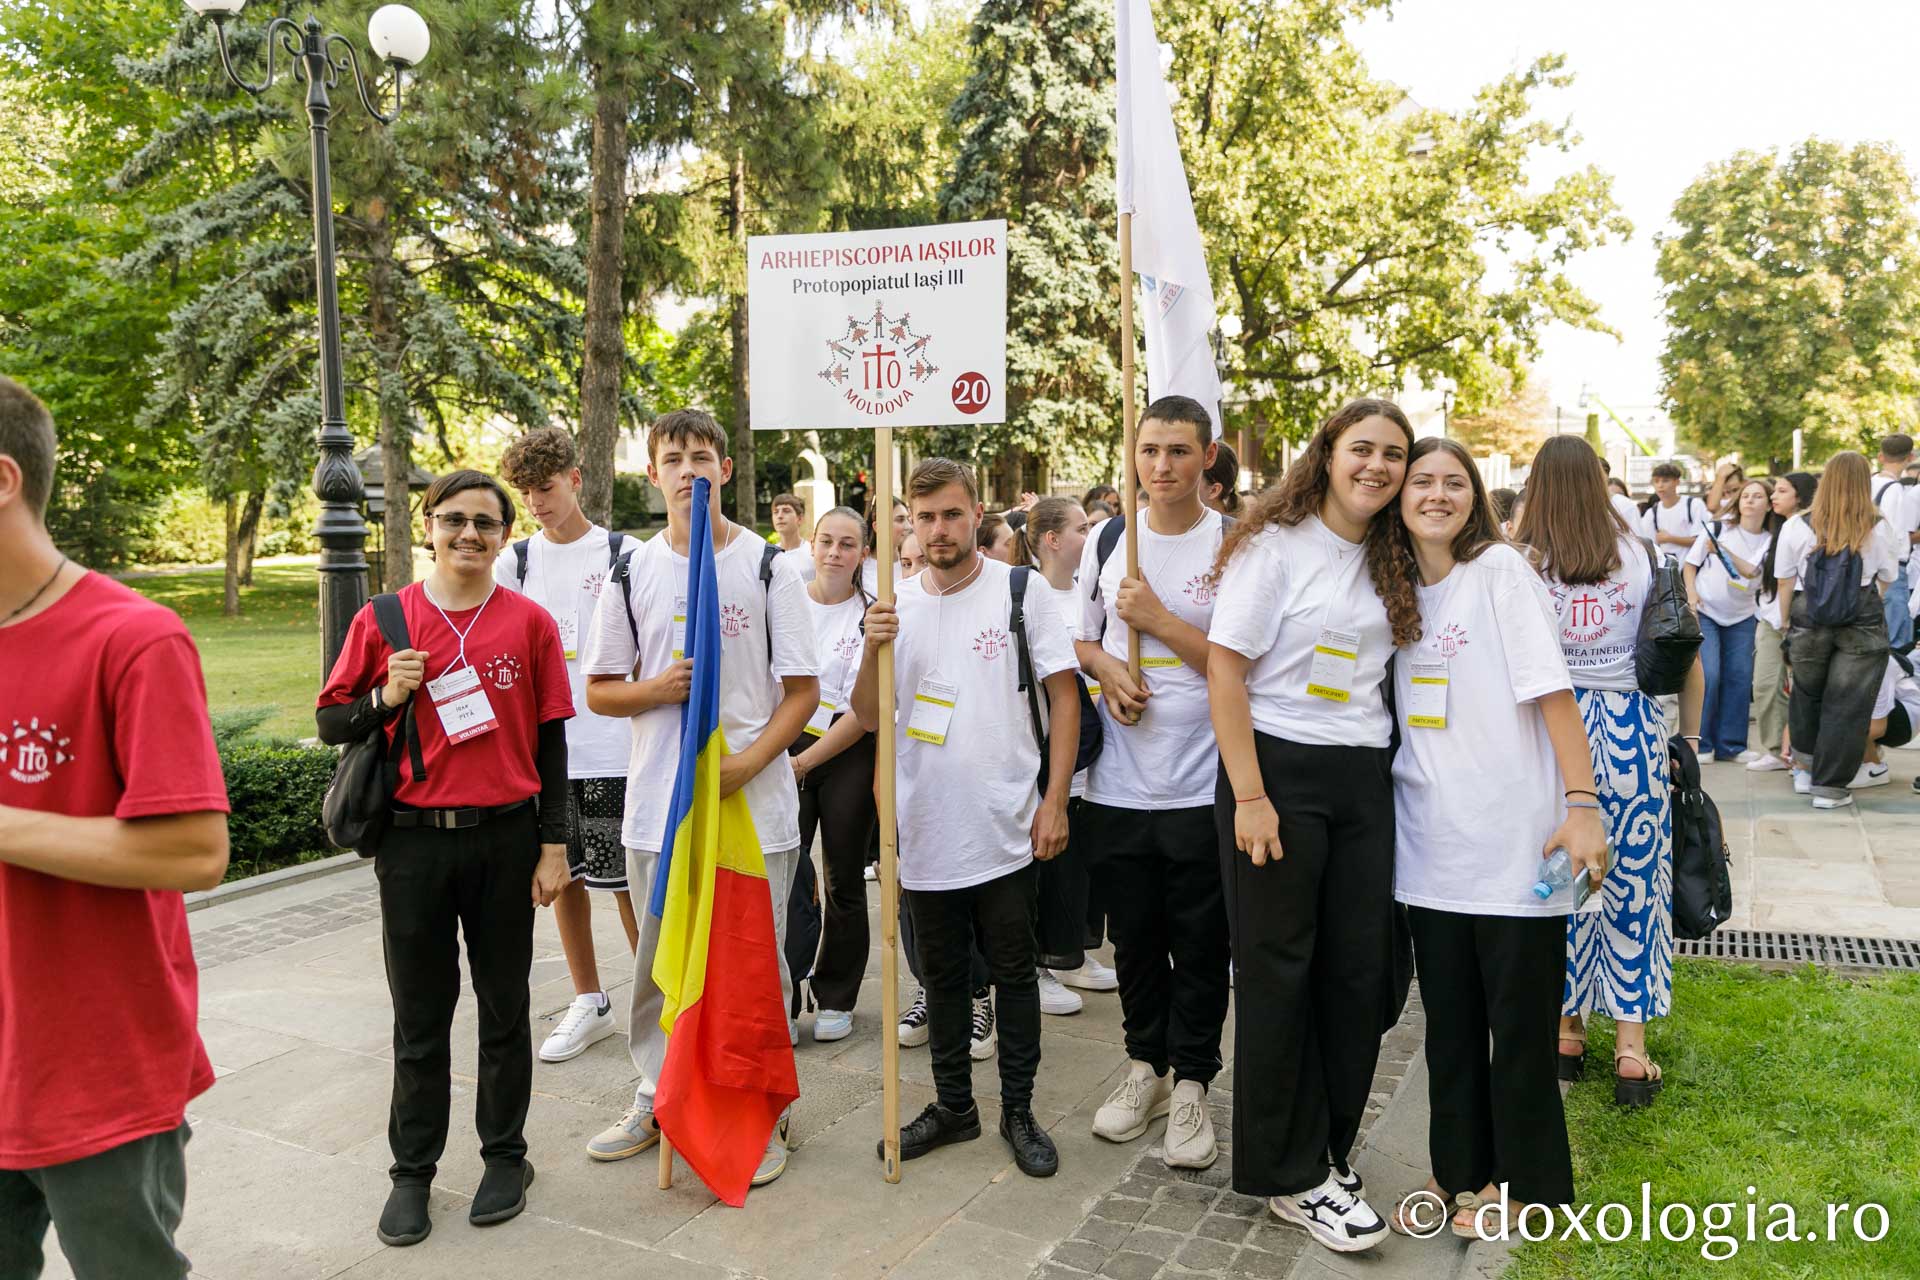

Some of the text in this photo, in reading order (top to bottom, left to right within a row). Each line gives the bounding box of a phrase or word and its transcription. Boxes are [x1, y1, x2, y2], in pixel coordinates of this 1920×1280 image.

[760, 237, 996, 270] ARHIEPISCOPIA IAȘILOR
[793, 269, 964, 295] Protopopiatul Iași III
[843, 388, 914, 416] MOLDOVA
[954, 379, 990, 405] 20
[1561, 625, 1611, 643] MOLDOVA
[458, 724, 489, 739] VOLUNTAR
